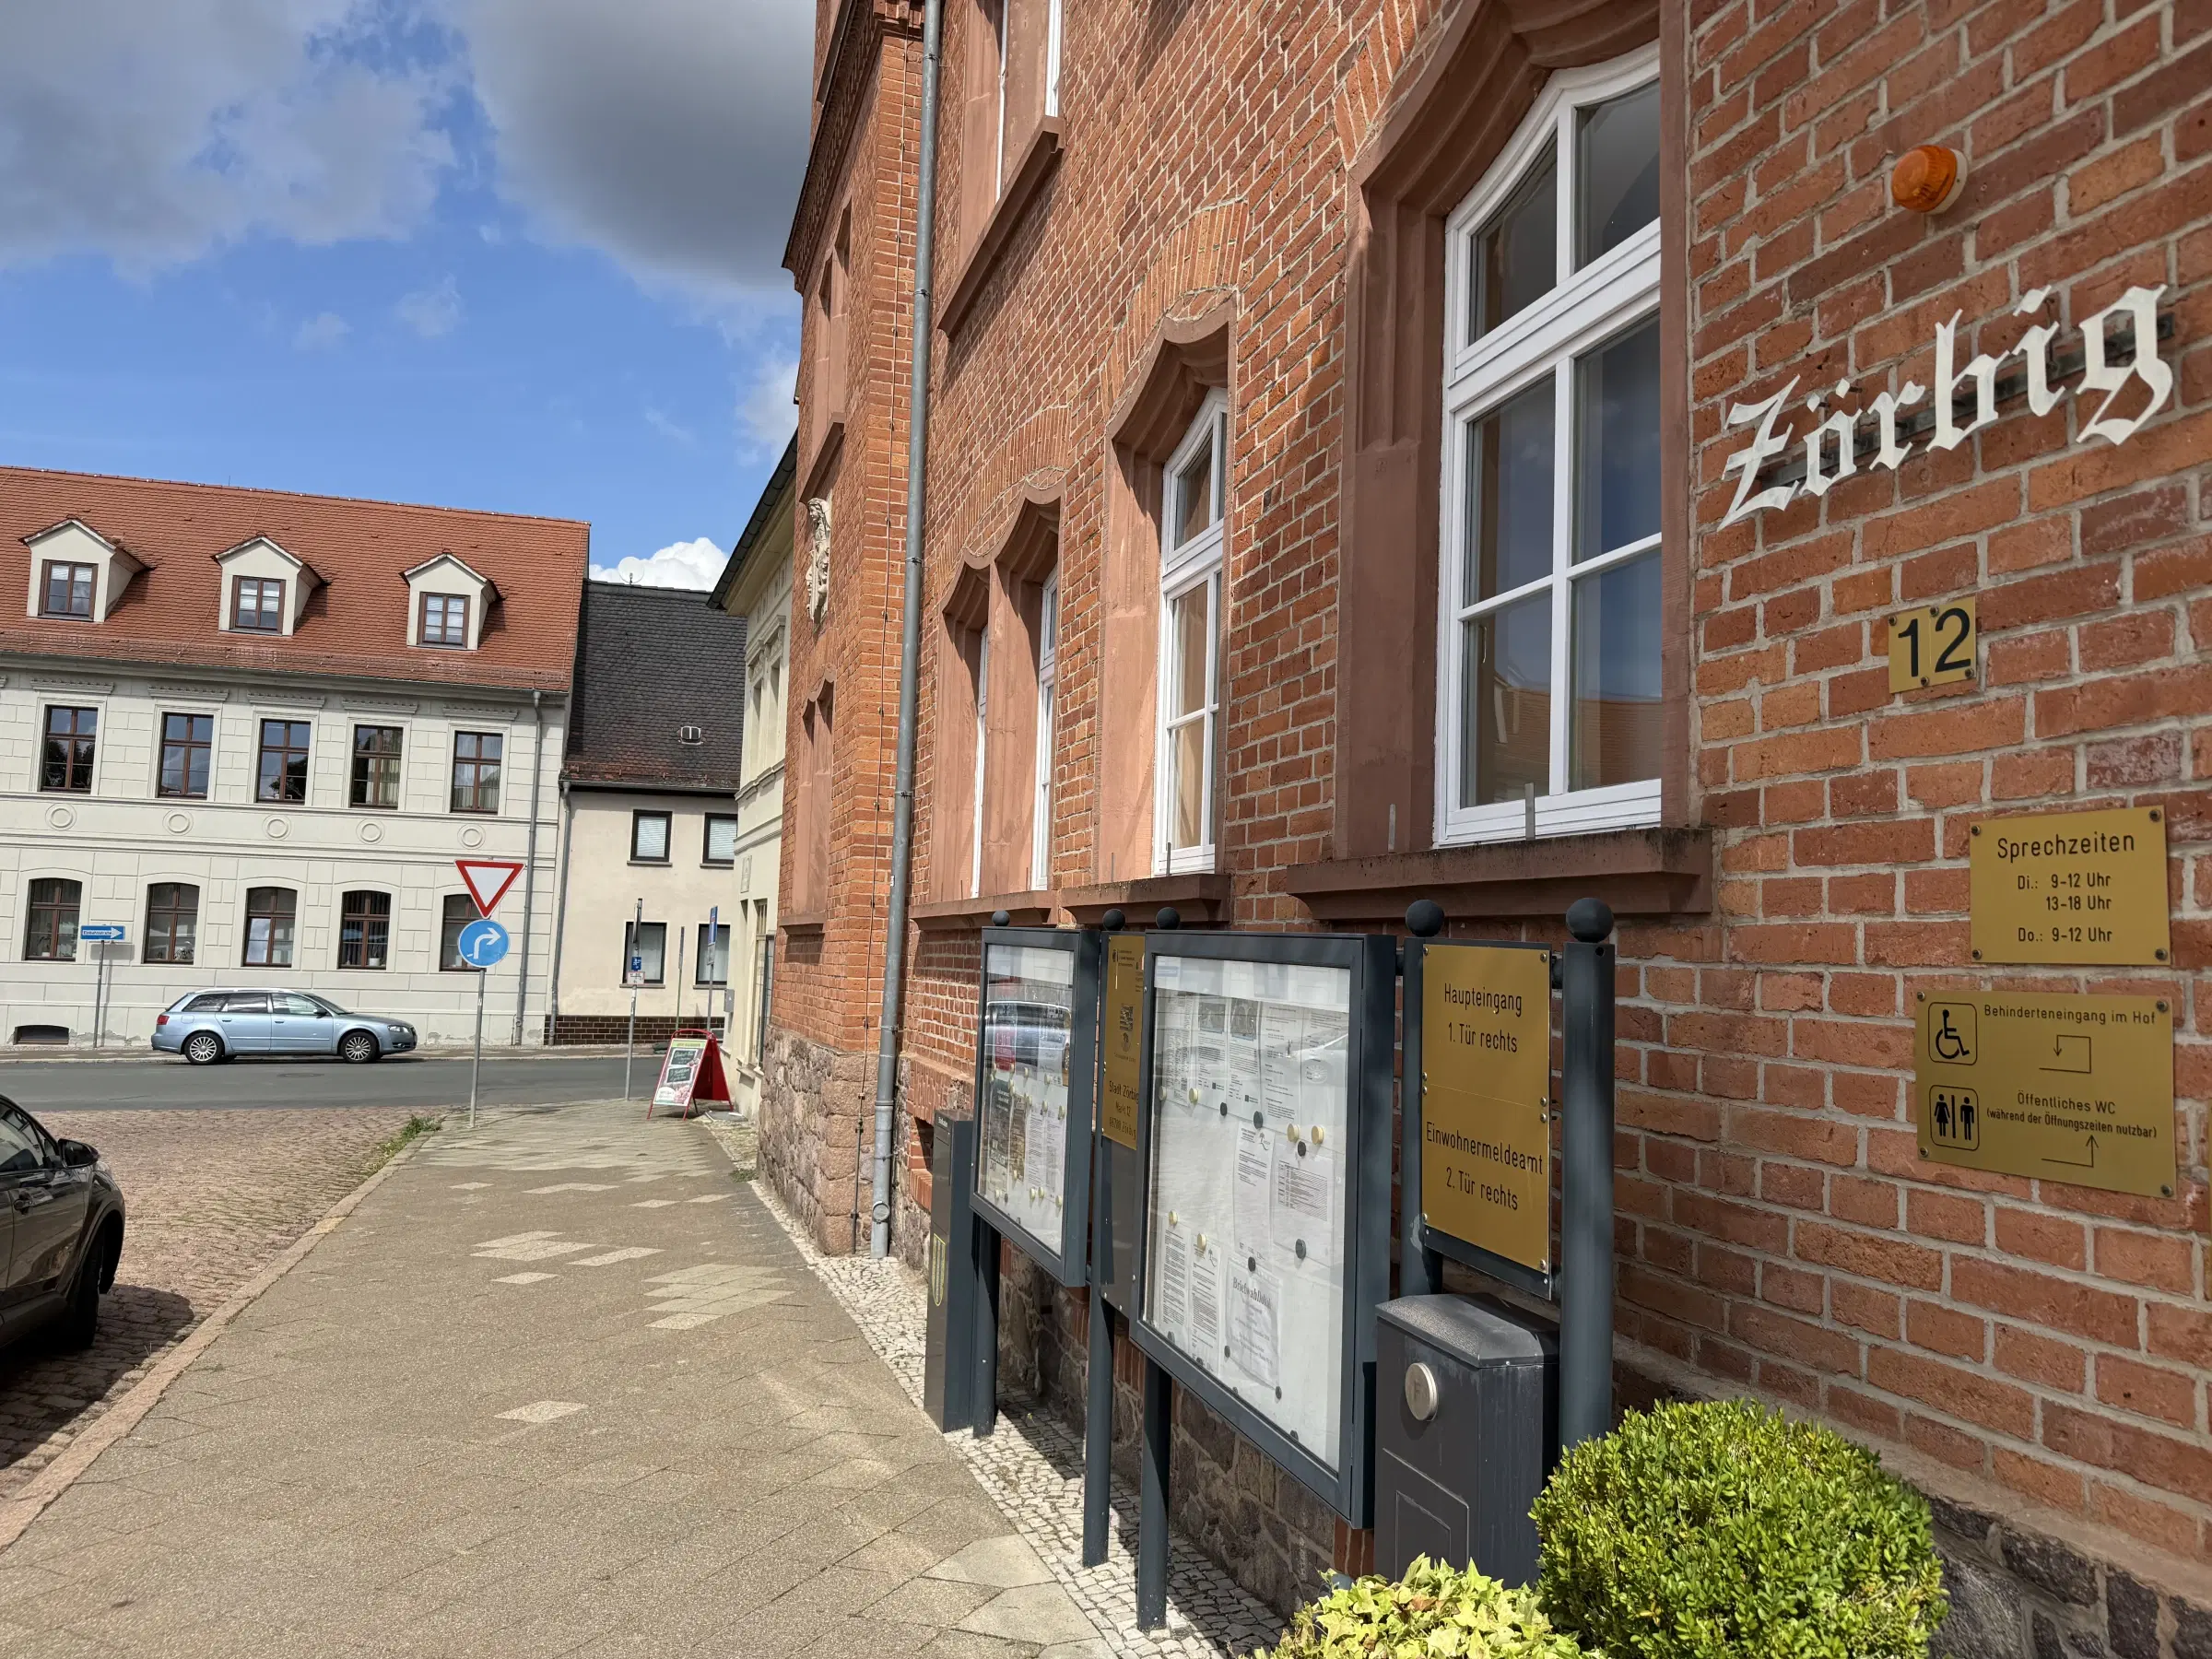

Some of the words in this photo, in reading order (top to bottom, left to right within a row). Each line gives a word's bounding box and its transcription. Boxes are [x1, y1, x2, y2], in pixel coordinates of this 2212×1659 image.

[1717, 285, 2173, 531] Zörbig
[1897, 607, 1972, 677] 12
[1996, 830, 2136, 863] Sprechzeiten
[2017, 874, 2039, 890] Di.:
[2051, 873, 2081, 888] 9-12
[2087, 873, 2112, 888] Uhr
[2046, 896, 2081, 911] 13-18
[2087, 896, 2112, 911] Uhr
[2018, 927, 2043, 943] Do.:
[2052, 927, 2083, 943] 9-12
[2088, 927, 2113, 942] Uhr
[1443, 982, 1523, 1018] Haupteingang
[1983, 1004, 2106, 1025] Behinderteneingang
[2111, 1010, 2128, 1024] im
[2132, 1011, 2157, 1025] Hof
[1448, 1022, 1456, 1043] 1.
[1459, 1023, 1477, 1046] Tür
[1480, 1027, 1519, 1053] rechts
[2018, 1090, 2091, 1112] Öffentliches
[2095, 1100, 2117, 1115] WC
[1986, 1108, 2025, 1124] (während
[2028, 1112, 2041, 1125] der
[2044, 1112, 2113, 1135] Öffnungszeiten
[2116, 1120, 2158, 1139] nutzbar)
[1426, 1121, 1544, 1175] Einwohnermeldeamt
[1446, 1167, 1455, 1189] 2.
[1458, 1170, 1477, 1195] Tür
[1480, 1182, 1519, 1211] rechts
